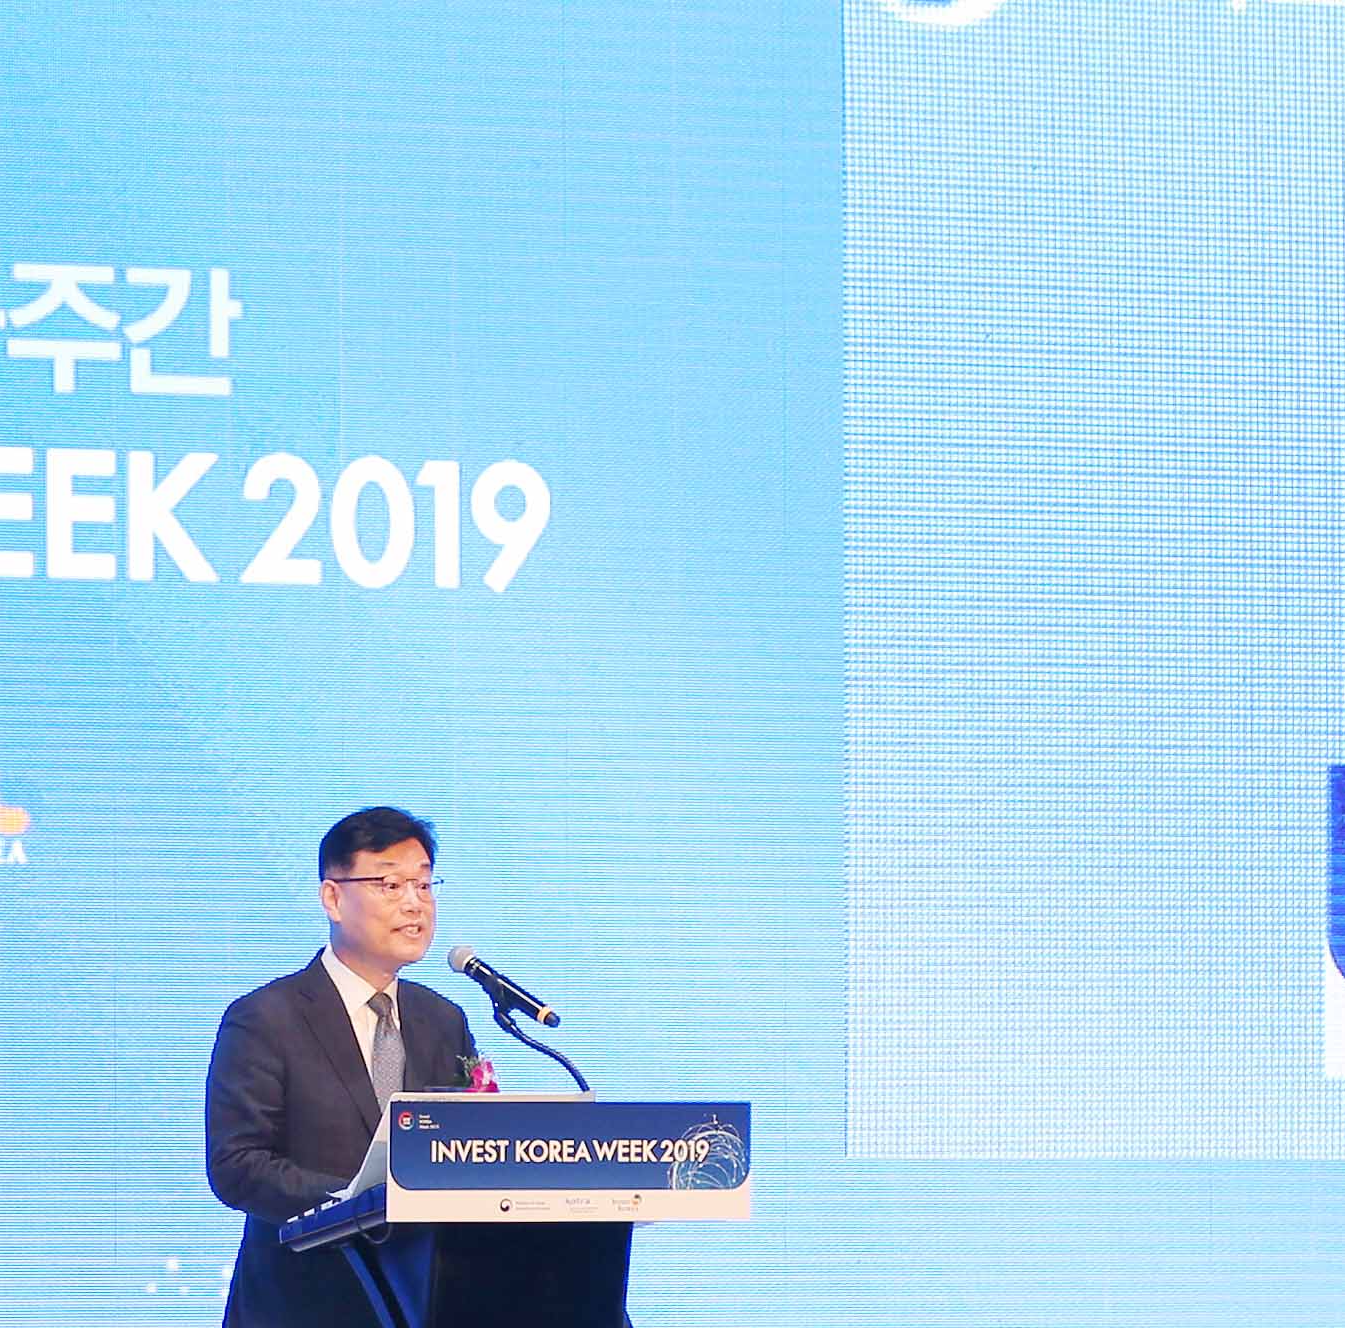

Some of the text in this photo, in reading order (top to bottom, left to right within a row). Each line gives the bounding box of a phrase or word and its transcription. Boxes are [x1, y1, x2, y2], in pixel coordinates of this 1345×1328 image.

[238, 451, 553, 594] 2019
[430, 1139, 710, 1164] INVEST KOREA WEEK 2019
